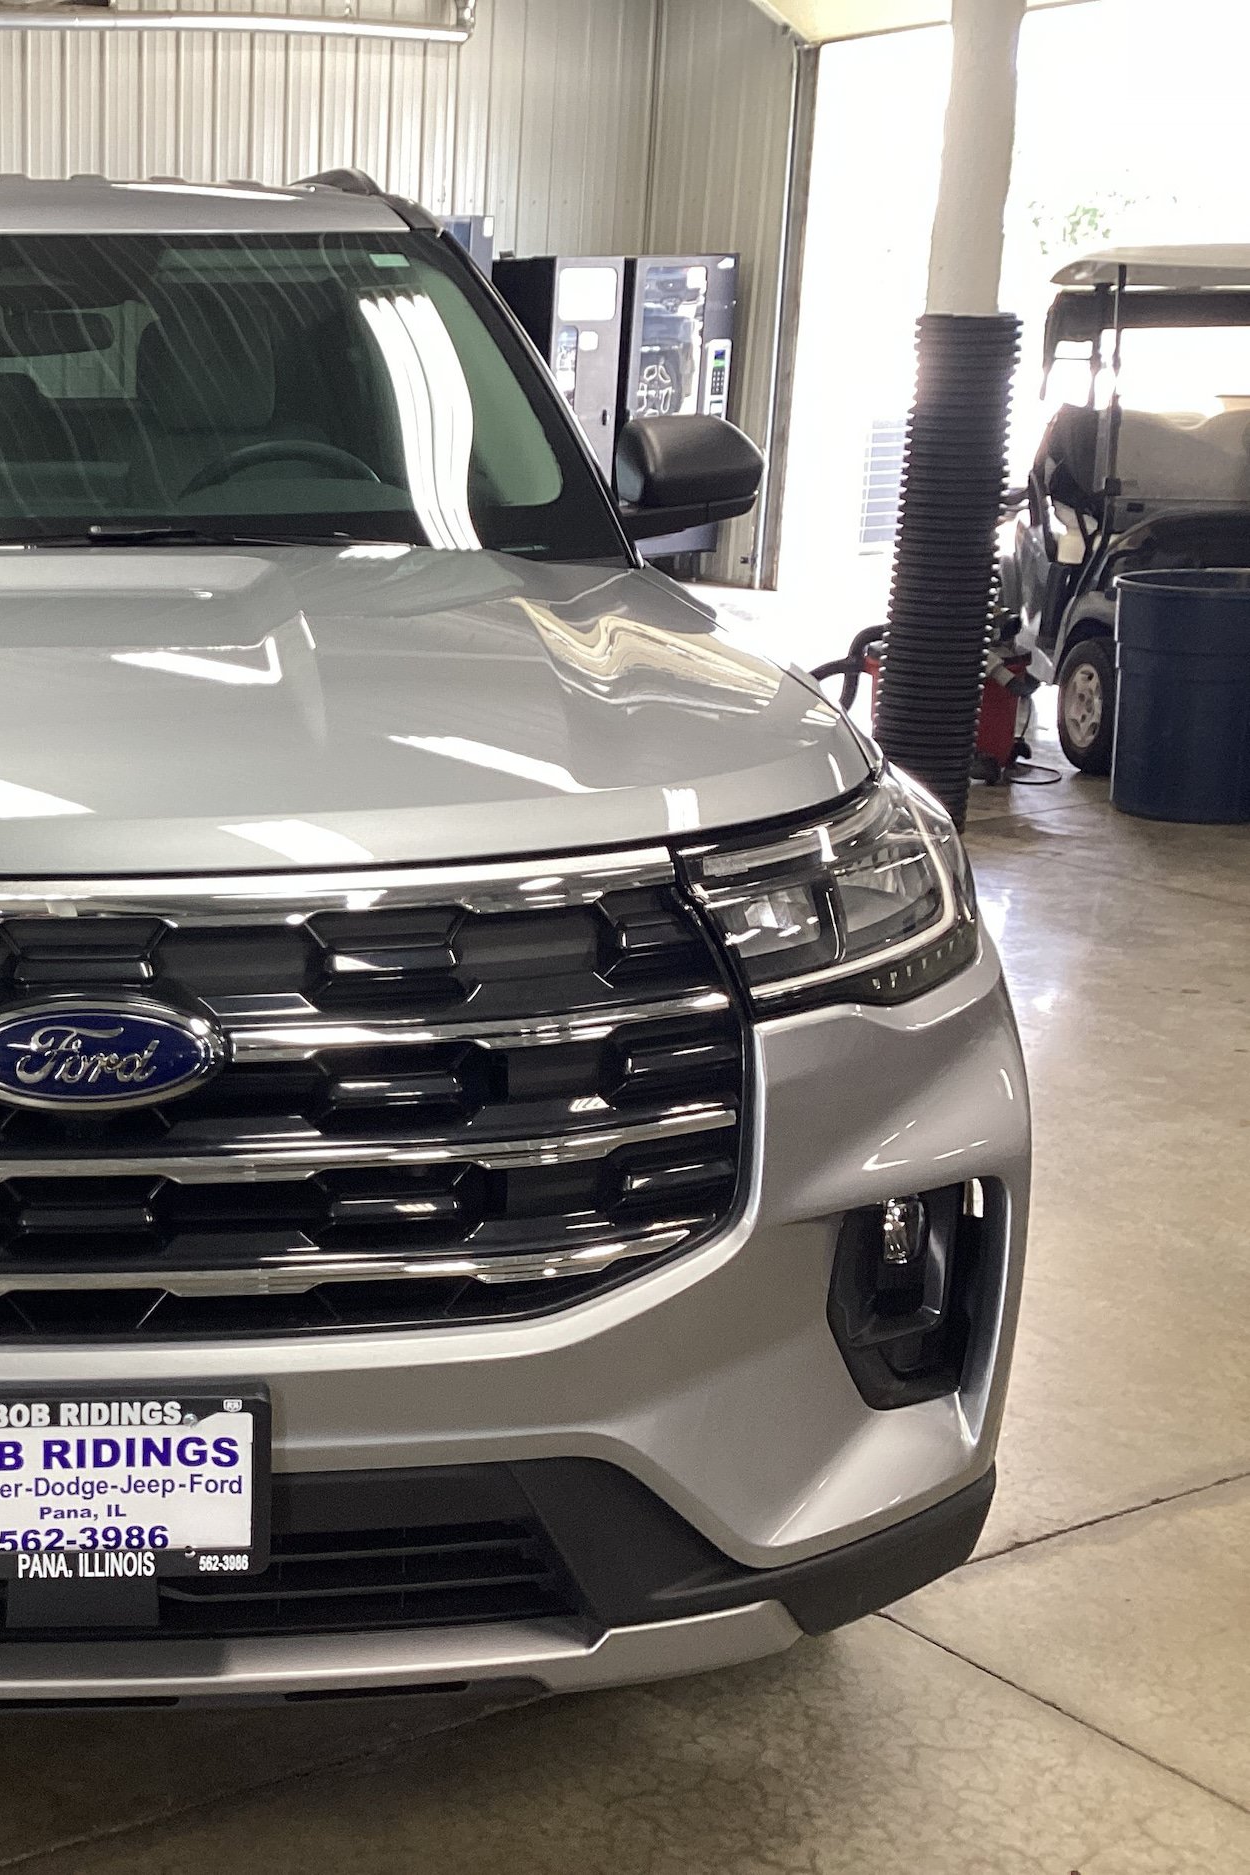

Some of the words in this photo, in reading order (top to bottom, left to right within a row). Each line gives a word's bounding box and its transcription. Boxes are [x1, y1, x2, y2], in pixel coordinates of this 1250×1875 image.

[6, 1025, 160, 1084] Ford
[59, 1400, 183, 1427] RIDINGS
[42, 1436, 240, 1470] RIDINGS
[39, 1506, 99, 1522] Pana,
[106, 1503, 127, 1518] IL
[17, 1552, 73, 1579] PANA,
[78, 1551, 156, 1577] ILLINOIS
[198, 1554, 249, 1571] 562-3986
